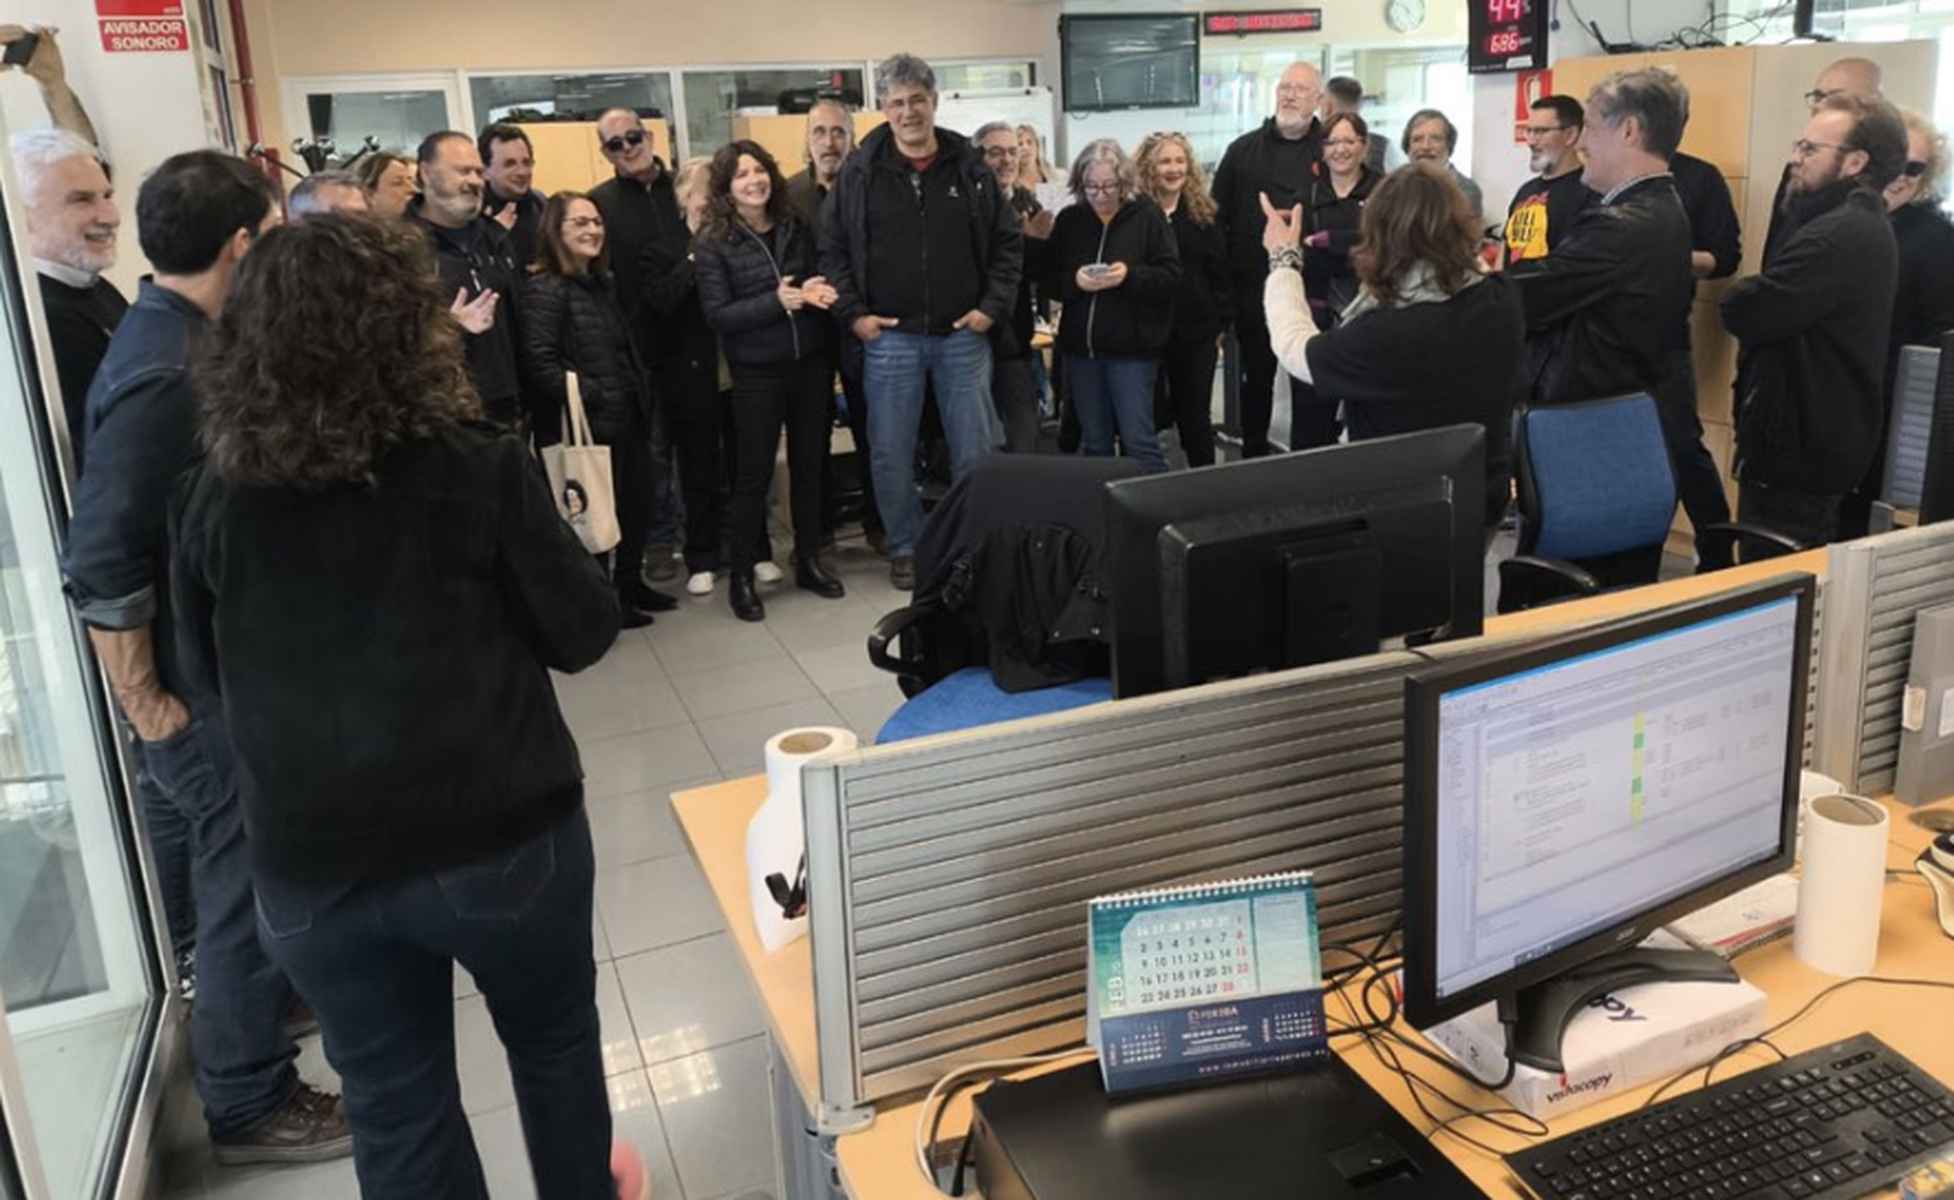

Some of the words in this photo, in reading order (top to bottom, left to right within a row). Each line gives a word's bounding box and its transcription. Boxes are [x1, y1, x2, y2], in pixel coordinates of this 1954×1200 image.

[104, 21, 183, 34] AVISADOR
[112, 36, 180, 49] SONORO
[1140, 943, 1147, 953] 2
[1157, 941, 1163, 951] 3
[1172, 939, 1179, 949] 4
[1189, 936, 1195, 946] 5
[1221, 931, 1228, 942] 7
[1155, 957, 1168, 967] 10
[1172, 955, 1183, 965] 11
[1188, 953, 1199, 963] 12
[1203, 950, 1214, 961] 13
[1220, 949, 1231, 959] 14
[1140, 976, 1152, 986] 16
[1157, 974, 1169, 984] 17
[1172, 971, 1184, 982] 18
[1189, 970, 1200, 980] 19
[1204, 967, 1217, 978] 20
[1221, 965, 1232, 976] 21
[1158, 990, 1170, 1001] 24
[1174, 988, 1186, 999] 25
[1190, 986, 1202, 997] 26
[1206, 983, 1218, 995] 27
